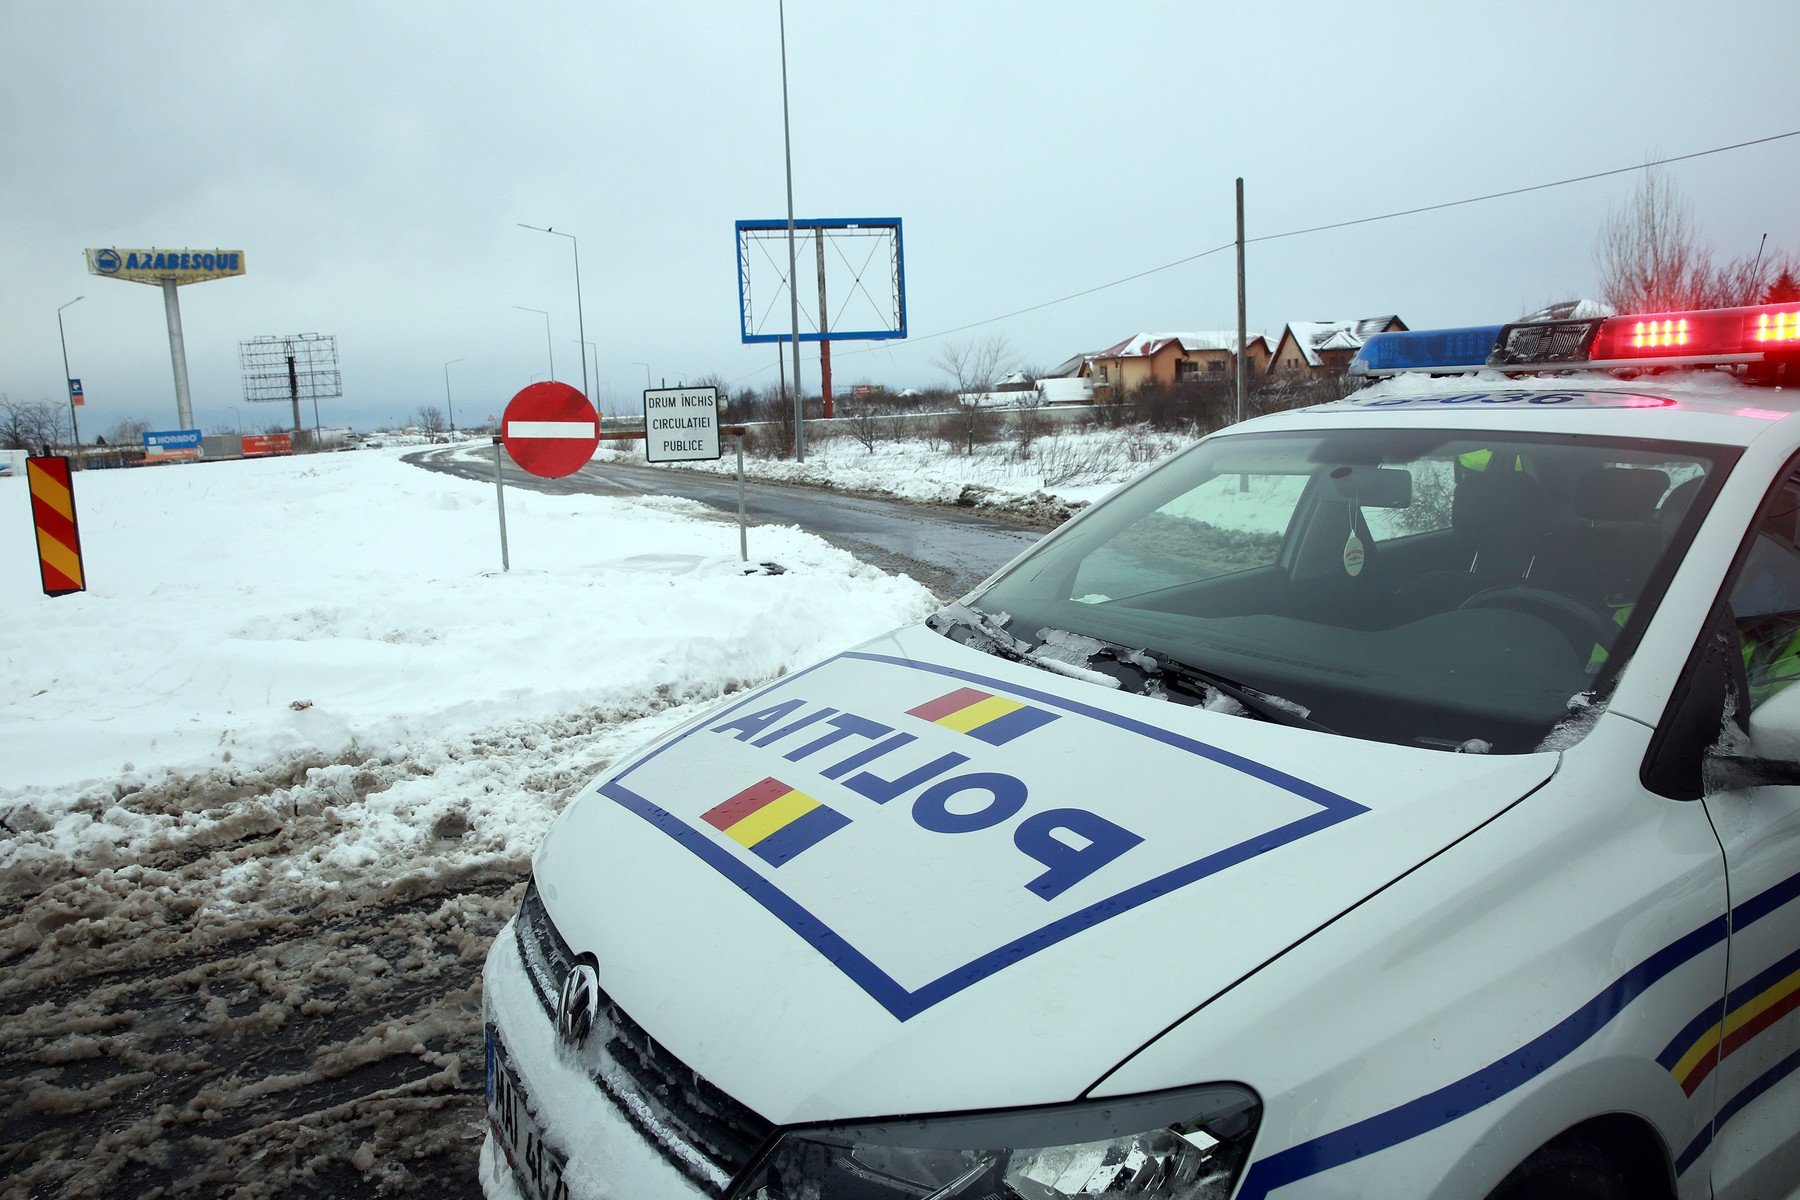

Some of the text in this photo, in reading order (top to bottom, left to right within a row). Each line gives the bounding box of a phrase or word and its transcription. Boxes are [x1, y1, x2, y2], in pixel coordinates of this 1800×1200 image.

[125, 253, 239, 271] ARABESQUE
[648, 393, 713, 408] DRUM ÎNCHIS
[663, 440, 704, 451] PUBLICE
